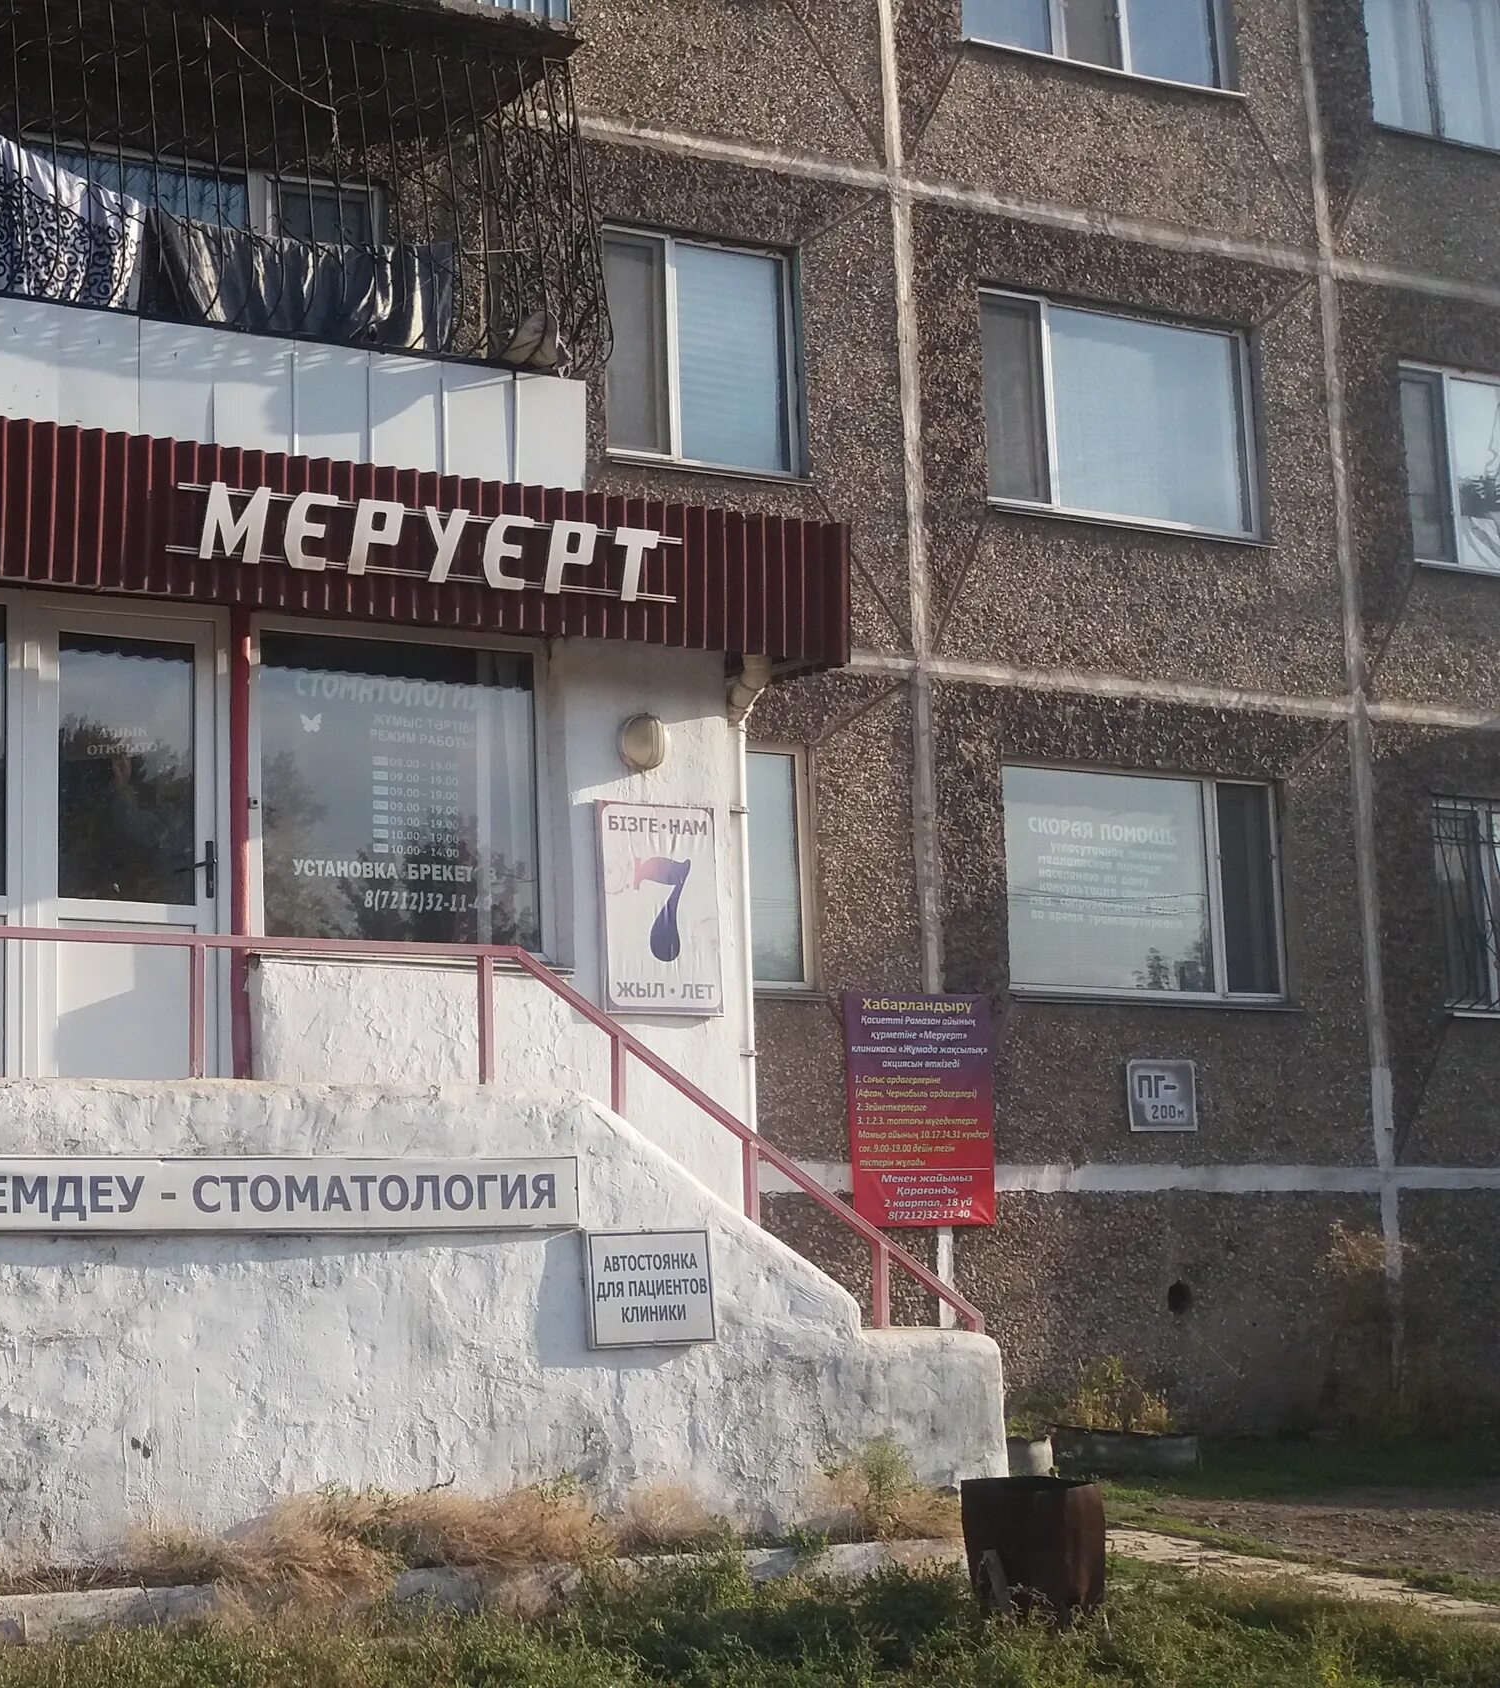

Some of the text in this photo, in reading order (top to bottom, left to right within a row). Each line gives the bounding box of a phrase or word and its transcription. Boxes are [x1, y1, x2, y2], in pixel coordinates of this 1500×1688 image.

[199, 481, 660, 602] МЕРУЕРТ
[370, 729, 416, 744] РЕЖИМ
[608, 815, 708, 836] БІЗГЕ НАМ
[1028, 816, 1176, 846] СКОРАЯ ПОМОЩЬ
[292, 858, 398, 880] УСТАНОВКА
[633, 856, 691, 962] 7
[617, 981, 714, 1000] ЖЫЛ ЛЕТ
[862, 997, 973, 1014] Хабарландыру
[856, 1103, 864, 1111] 2.
[881, 1173, 973, 1183] Мекен жайымыз
[192, 1173, 557, 1214] СТОМАТОЛОГИЯ
[884, 1199, 891, 1208] 2
[893, 1199, 943, 1209] квартал,
[946, 1198, 958, 1207] 18
[888, 1209, 970, 1221] 8(7212)32-11-40
[604, 1253, 698, 1272] АВТОСТОЯНКА
[597, 1278, 708, 1302] ДЛЯ ПАЦИЕНТОВ
[621, 1304, 687, 1323] КЛИНИКИ
